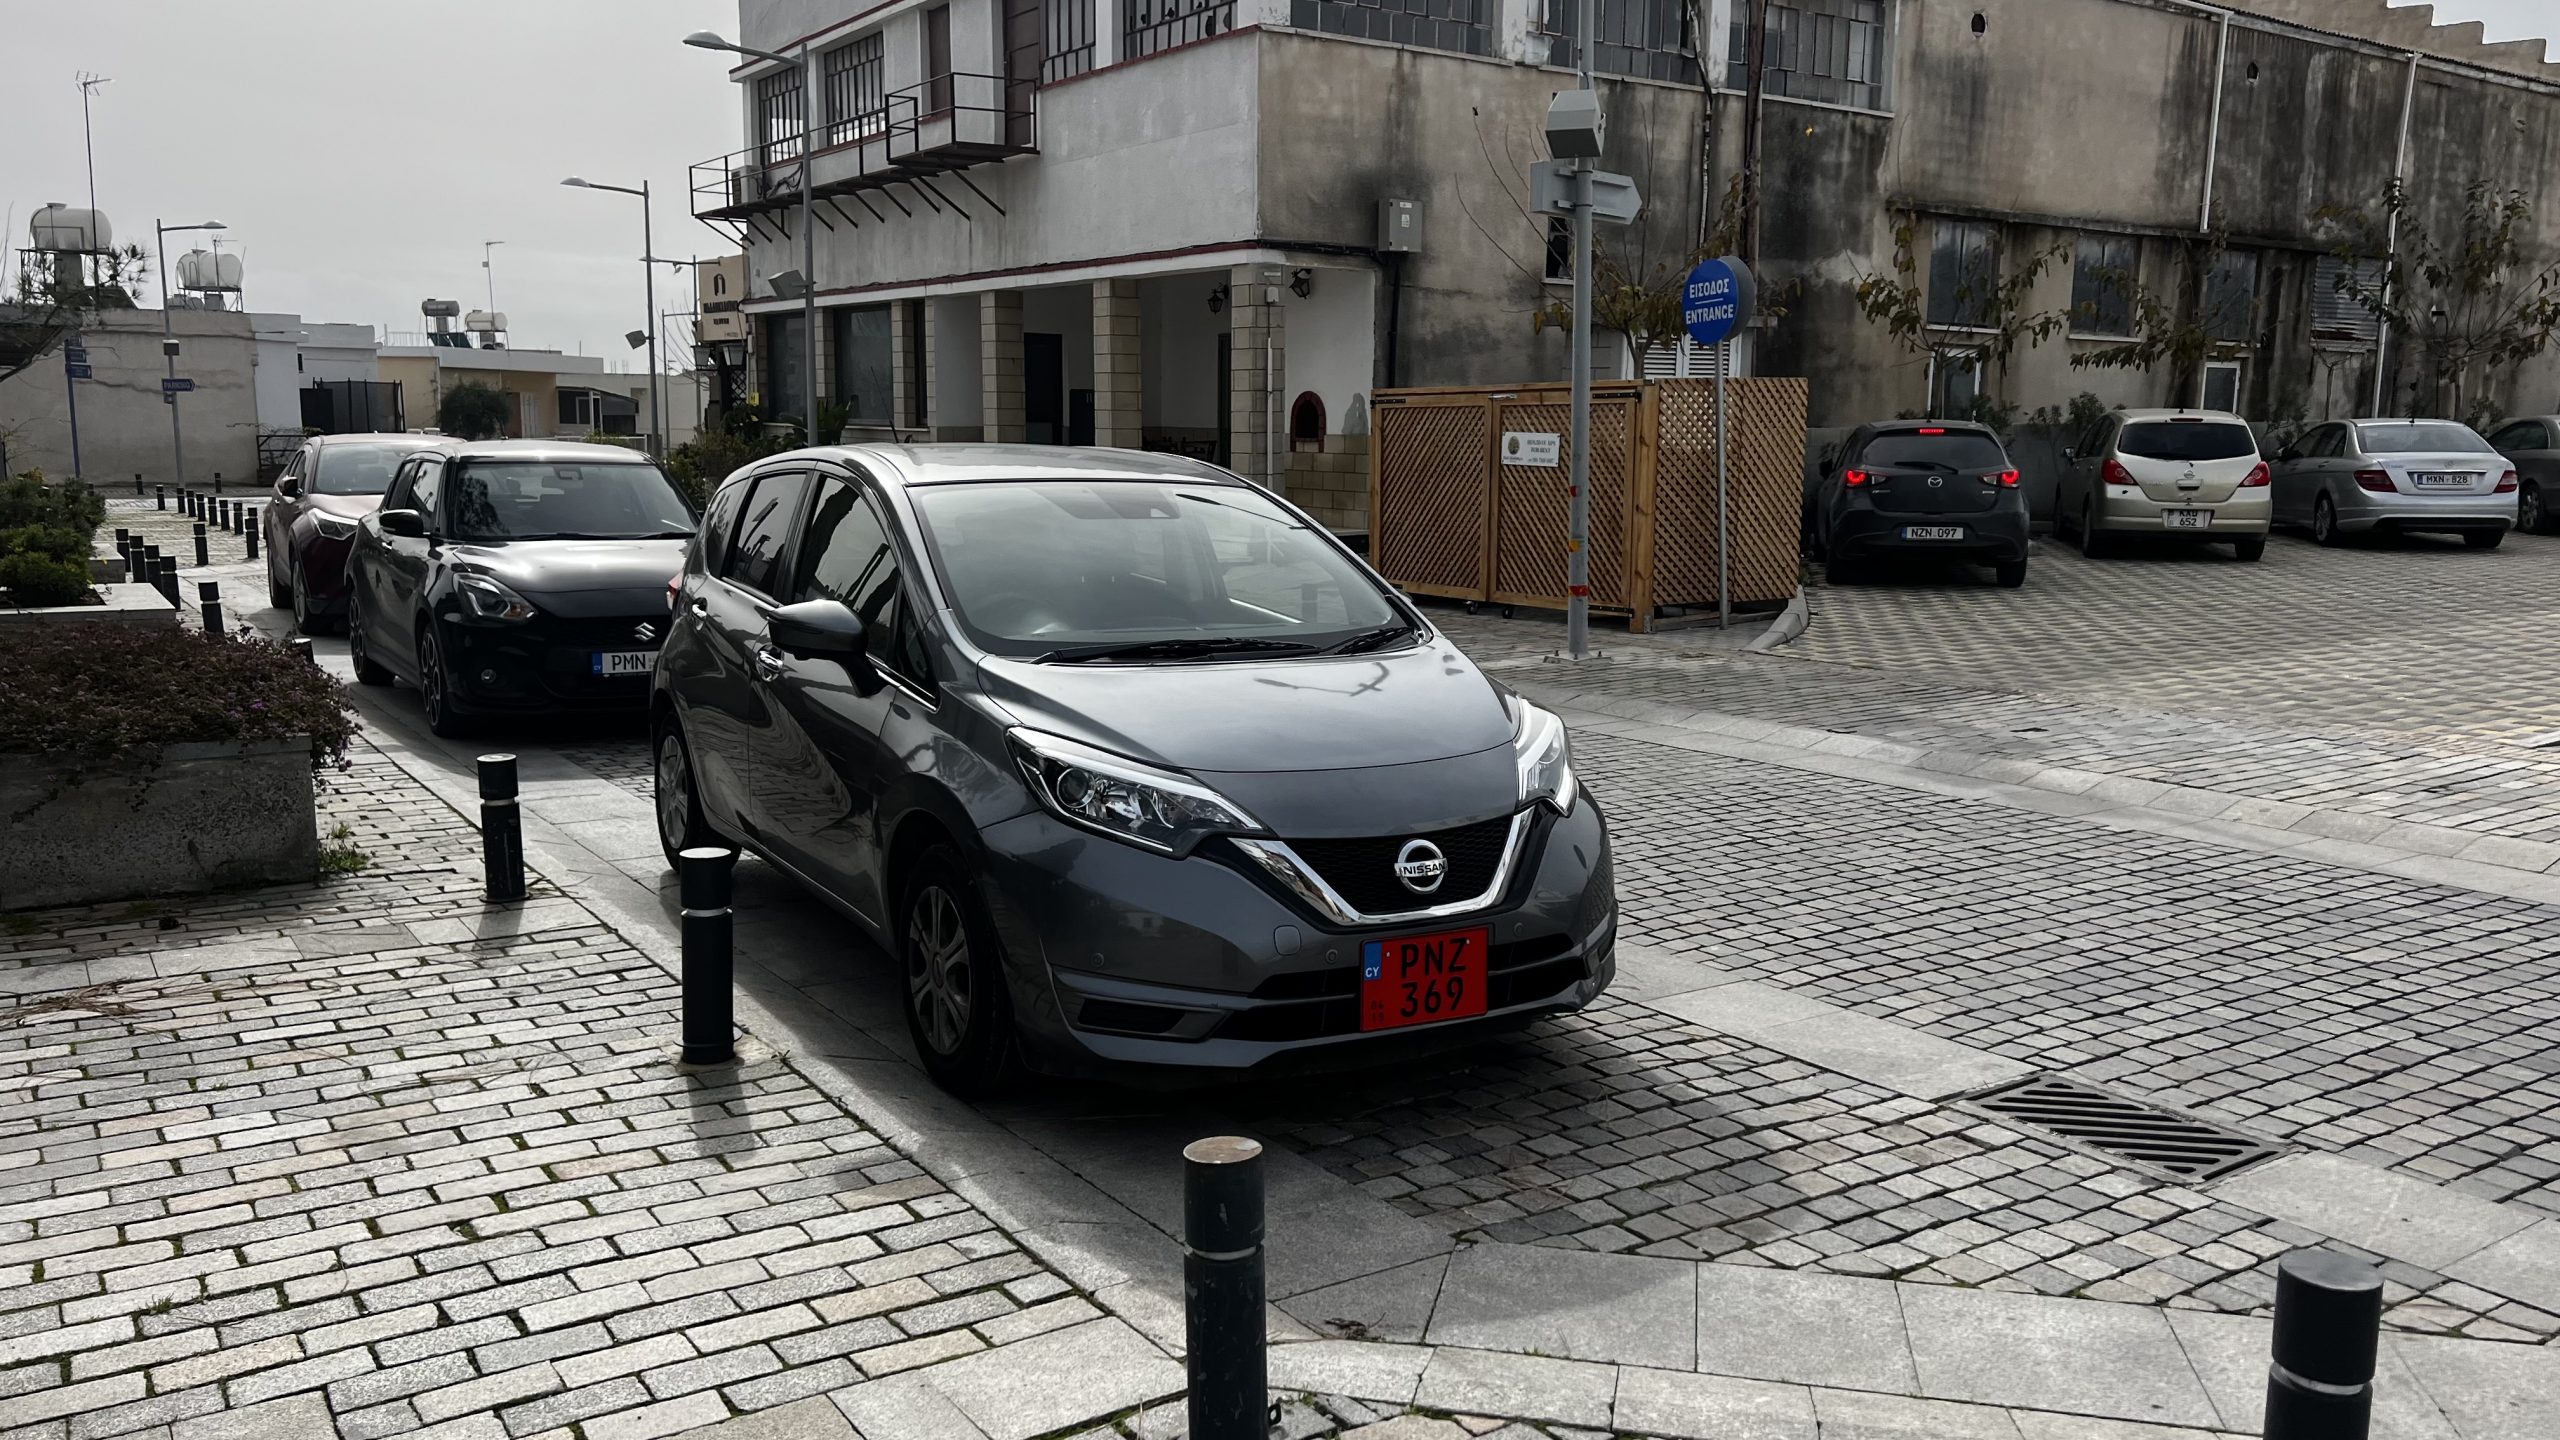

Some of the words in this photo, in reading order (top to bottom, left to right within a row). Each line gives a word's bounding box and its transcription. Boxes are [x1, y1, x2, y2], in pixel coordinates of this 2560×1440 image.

[1689, 278, 1730, 299] ΕΙΣΟΔΟΣ
[1685, 303, 1734, 325] ENTRANCE
[2179, 517, 2197, 526] 652
[1911, 527, 1932, 538] NZN
[1937, 527, 1957, 538] 097
[611, 653, 646, 671] PMN
[1403, 862, 1445, 875] NISSAN
[1401, 937, 1468, 979] PNZ
[1365, 965, 1380, 979] CY
[1401, 976, 1464, 1018] 369
